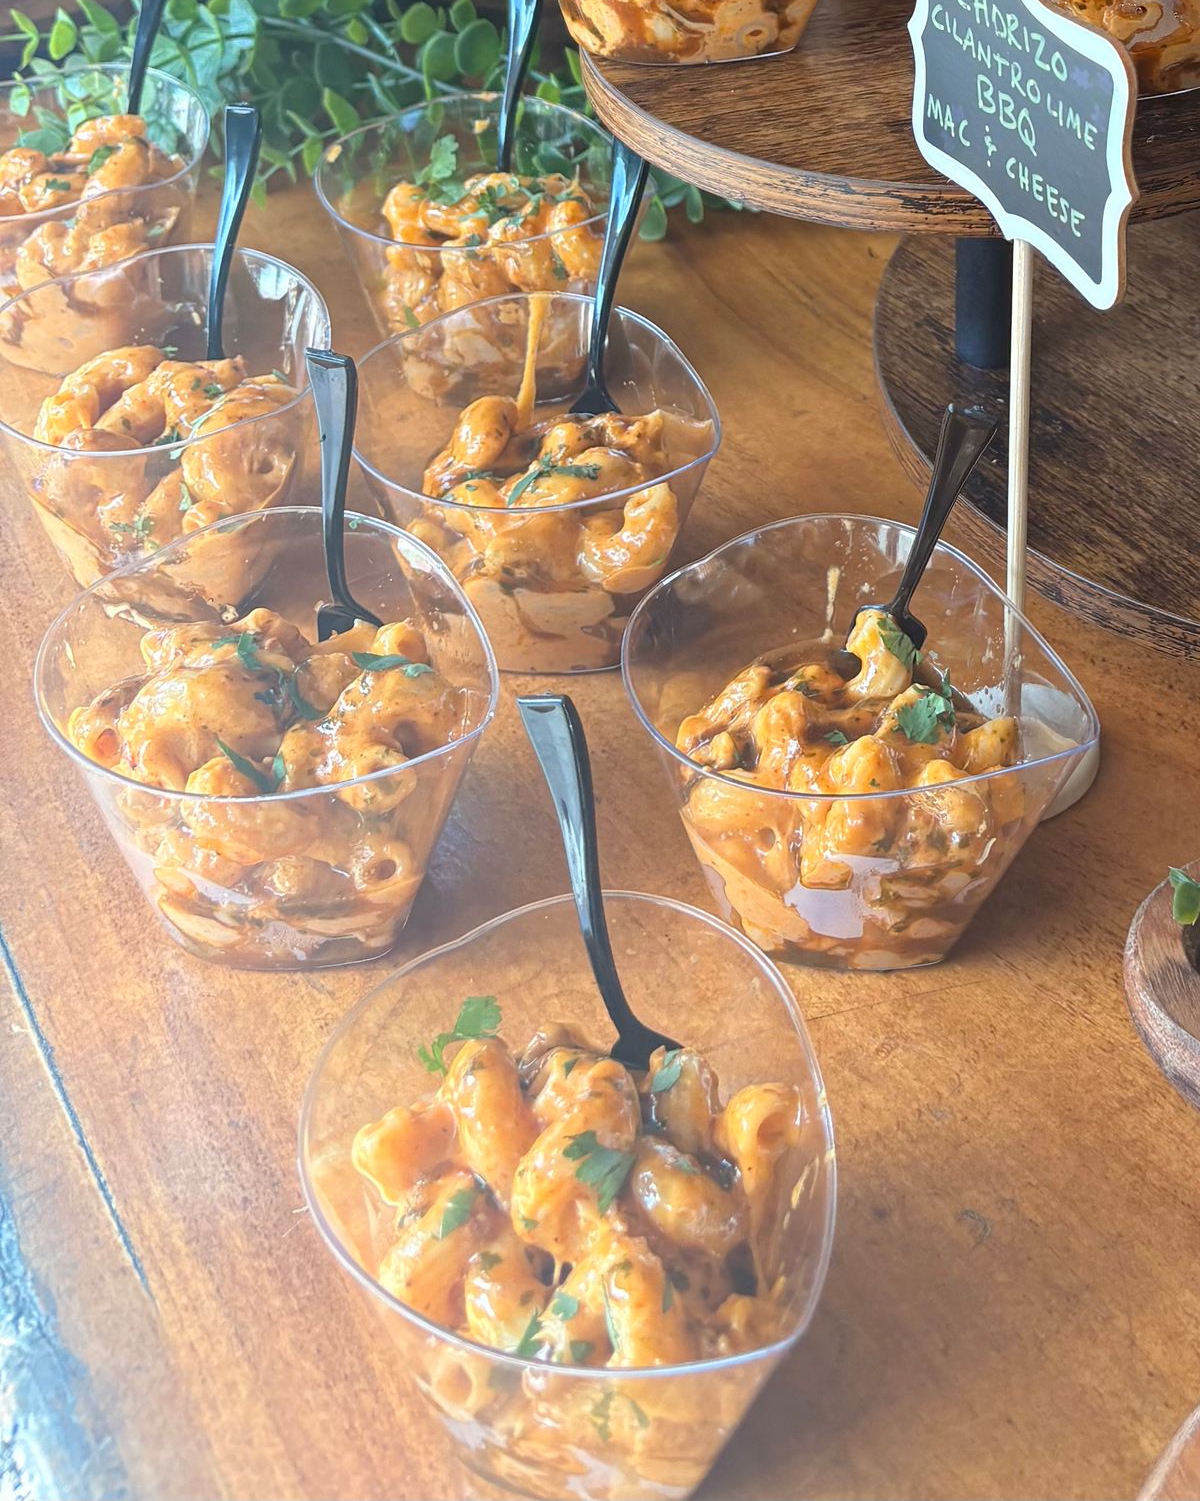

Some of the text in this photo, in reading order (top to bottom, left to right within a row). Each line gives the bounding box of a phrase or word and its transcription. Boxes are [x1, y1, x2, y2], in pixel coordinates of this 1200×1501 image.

[931, 4, 1099, 151] CILANTRO LIME
[976, 74, 1037, 157] BBQ
[926, 93, 971, 148] MAC
[1006, 156, 1086, 238] CHEESE
